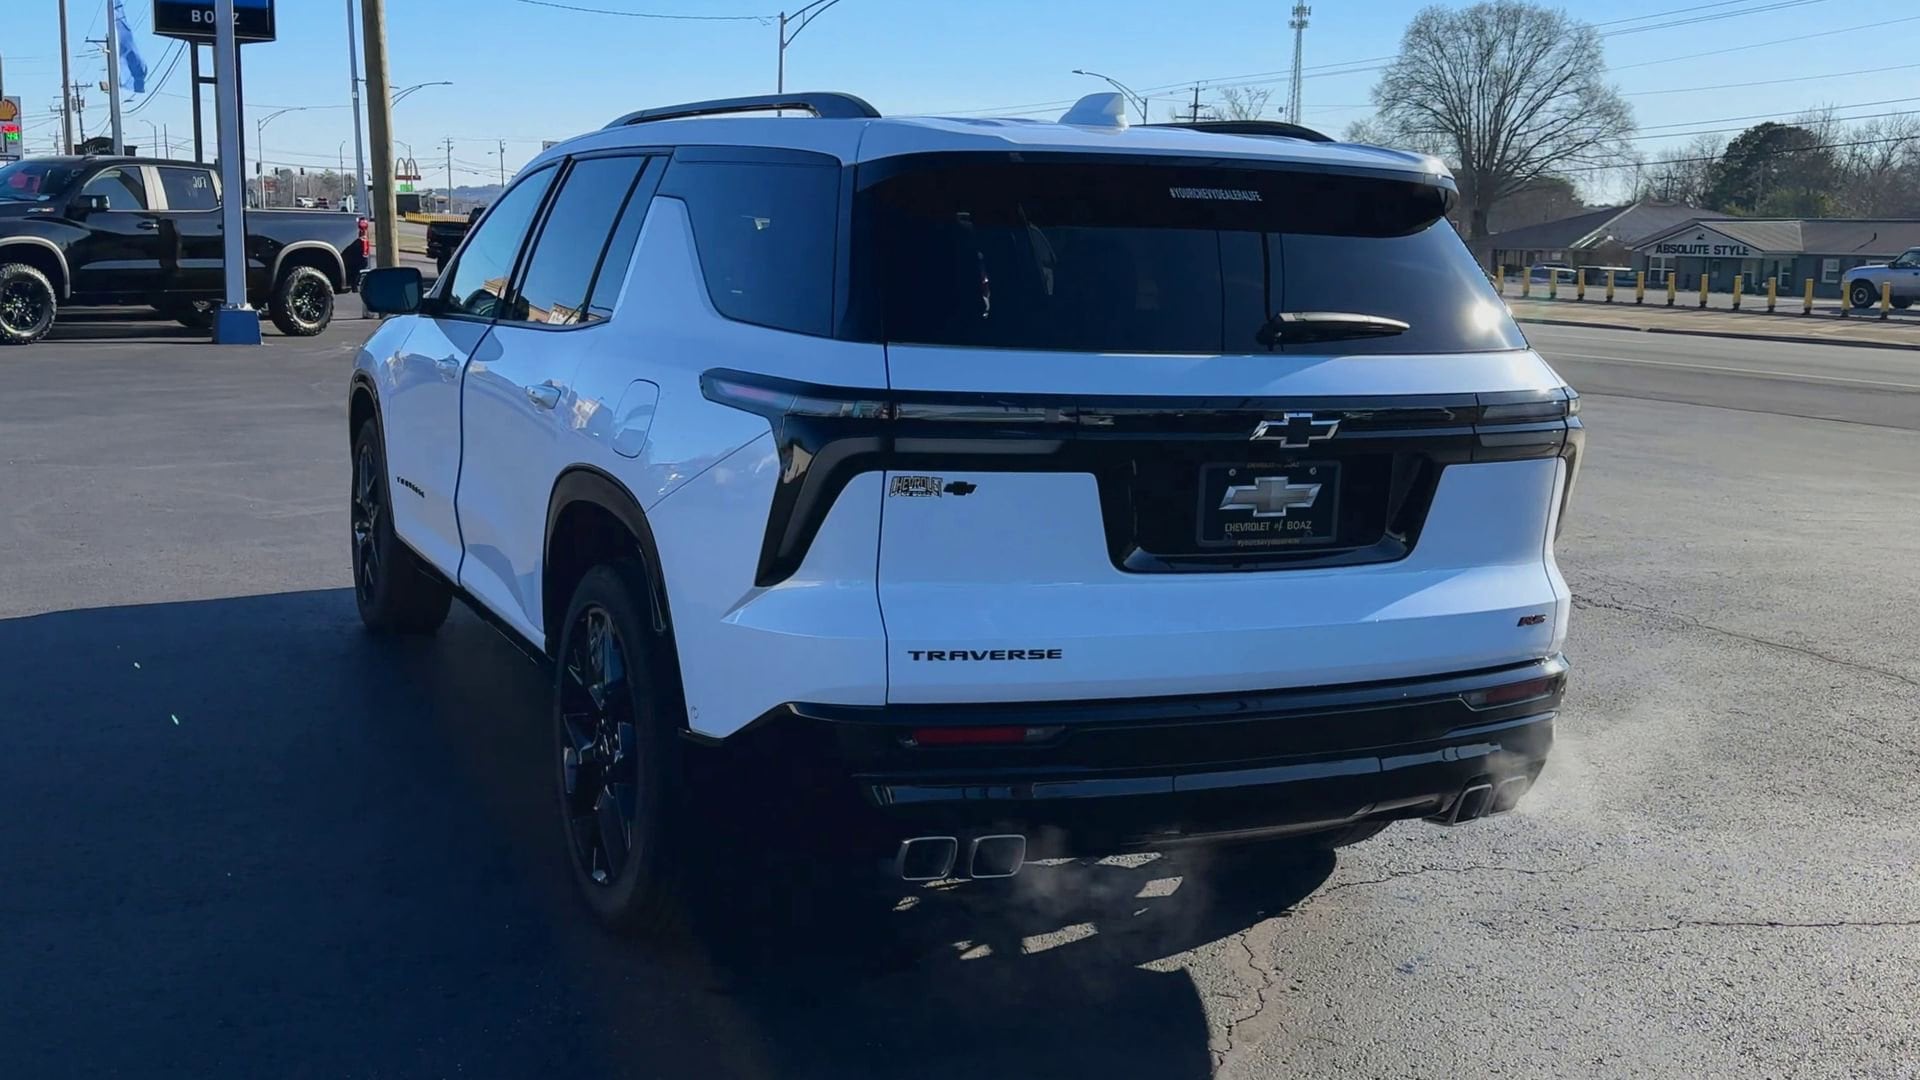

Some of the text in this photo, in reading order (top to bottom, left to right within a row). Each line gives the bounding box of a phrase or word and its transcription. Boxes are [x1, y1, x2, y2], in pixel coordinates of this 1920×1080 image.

[191, 9, 240, 25] BOZ
[1656, 243, 1749, 256] ABSOLUTE STYLE
[1224, 522, 1270, 532] CHEVROLET
[1287, 520, 1312, 530] BOAZ
[908, 649, 1063, 661] TRAVERSE
